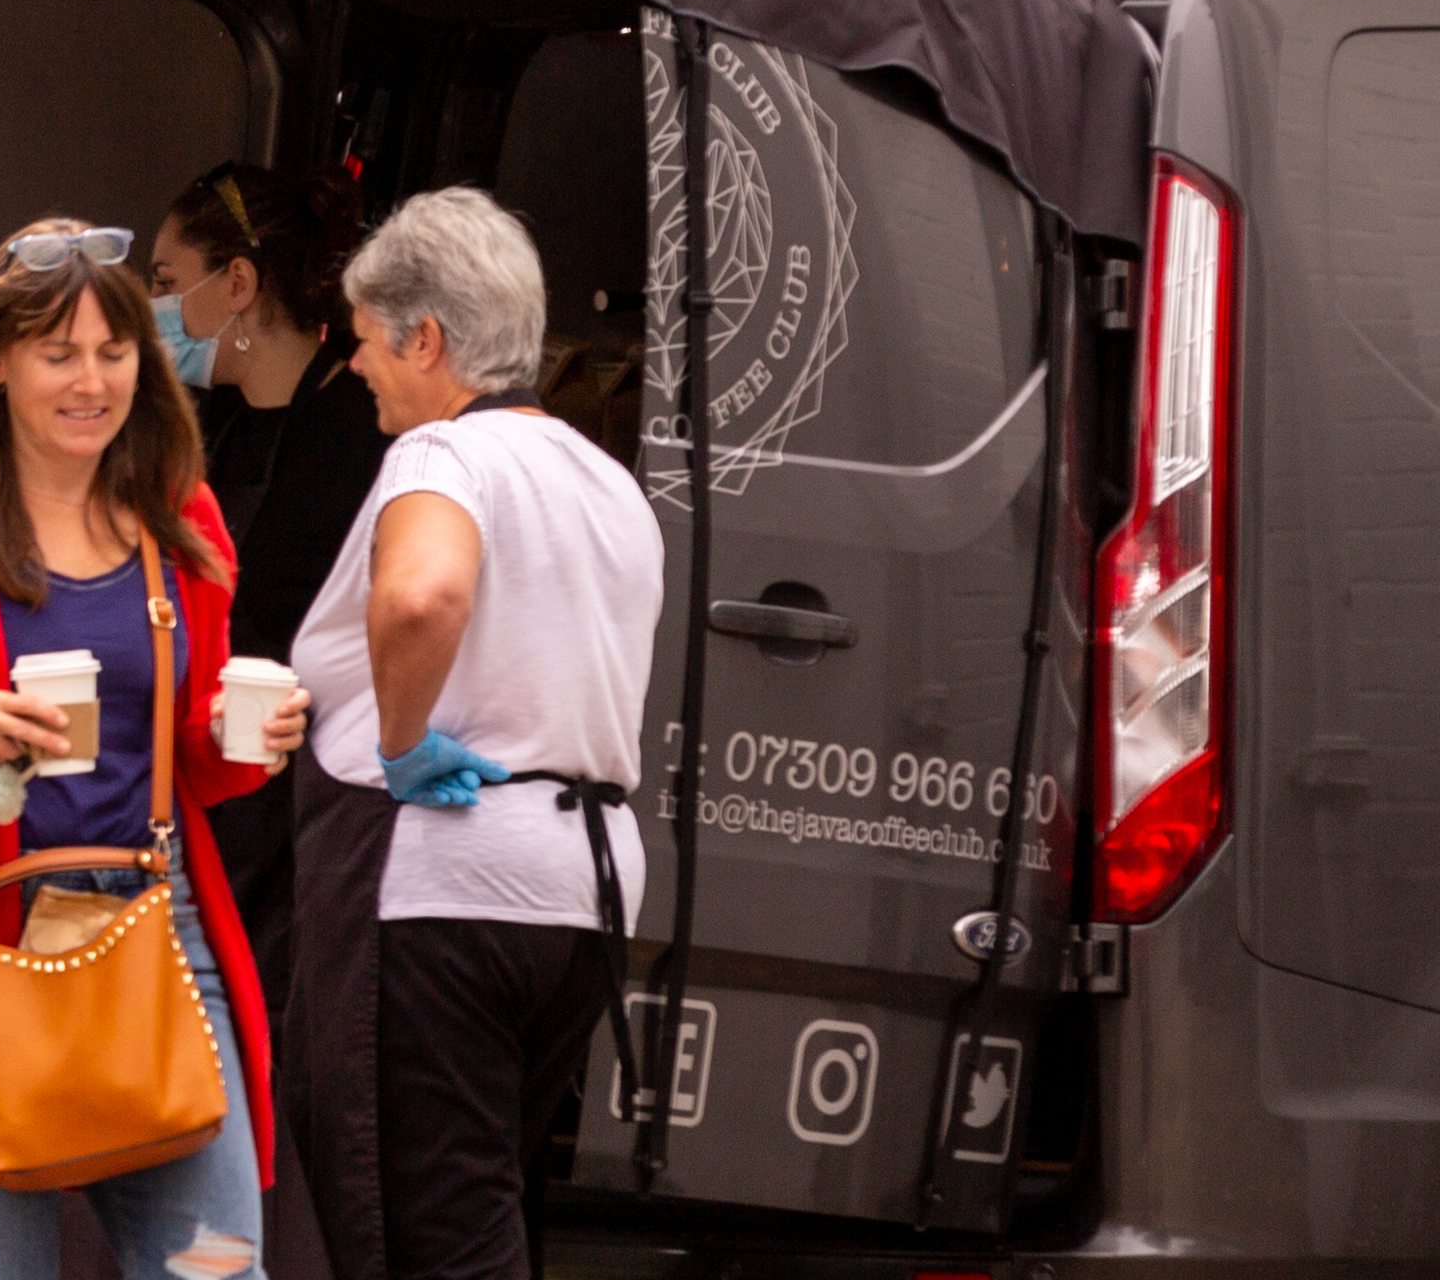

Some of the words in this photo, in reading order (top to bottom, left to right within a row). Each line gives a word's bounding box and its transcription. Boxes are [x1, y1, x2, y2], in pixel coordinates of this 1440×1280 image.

[707, 42, 781, 135] CLUB
[648, 358, 774, 445] COFEE
[765, 244, 812, 361] CLUB
[725, 731, 878, 798] 07309
[889, 751, 976, 811] 966
